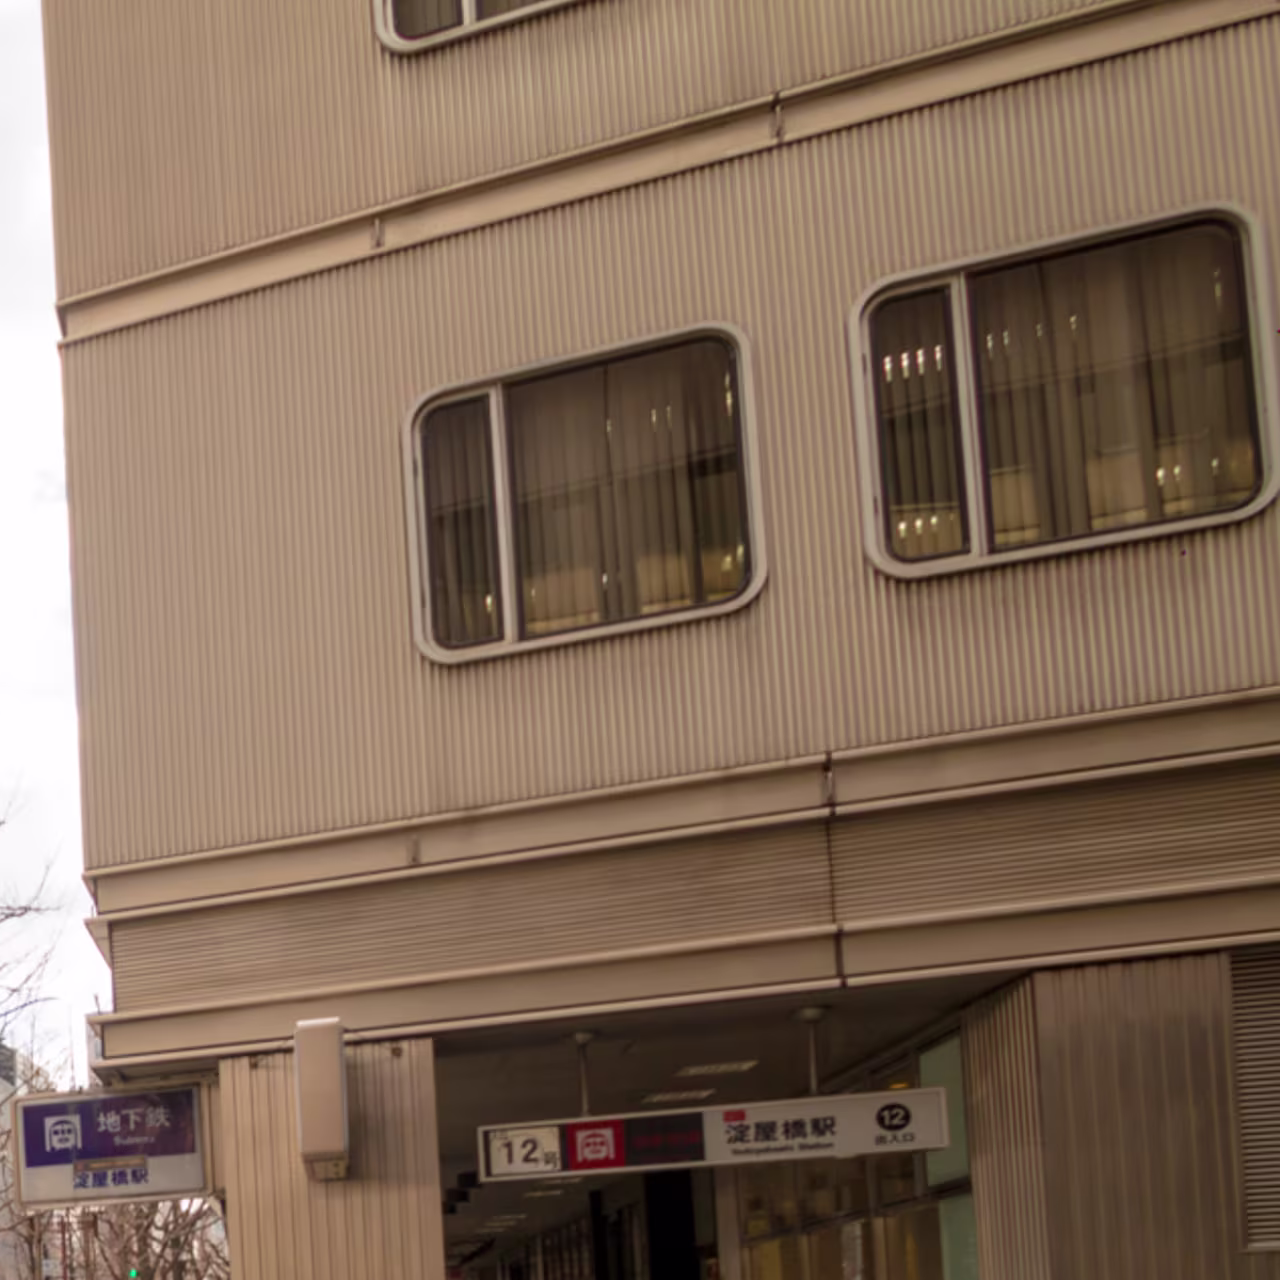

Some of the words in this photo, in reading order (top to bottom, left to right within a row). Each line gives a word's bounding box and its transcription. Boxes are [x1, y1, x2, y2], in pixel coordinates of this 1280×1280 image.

[96, 1105, 171, 1133] 地下鉄
[881, 1108, 908, 1126] 12
[725, 1115, 837, 1145] 淀屋橋駅
[73, 1168, 150, 1190] 淀屋橋駅
